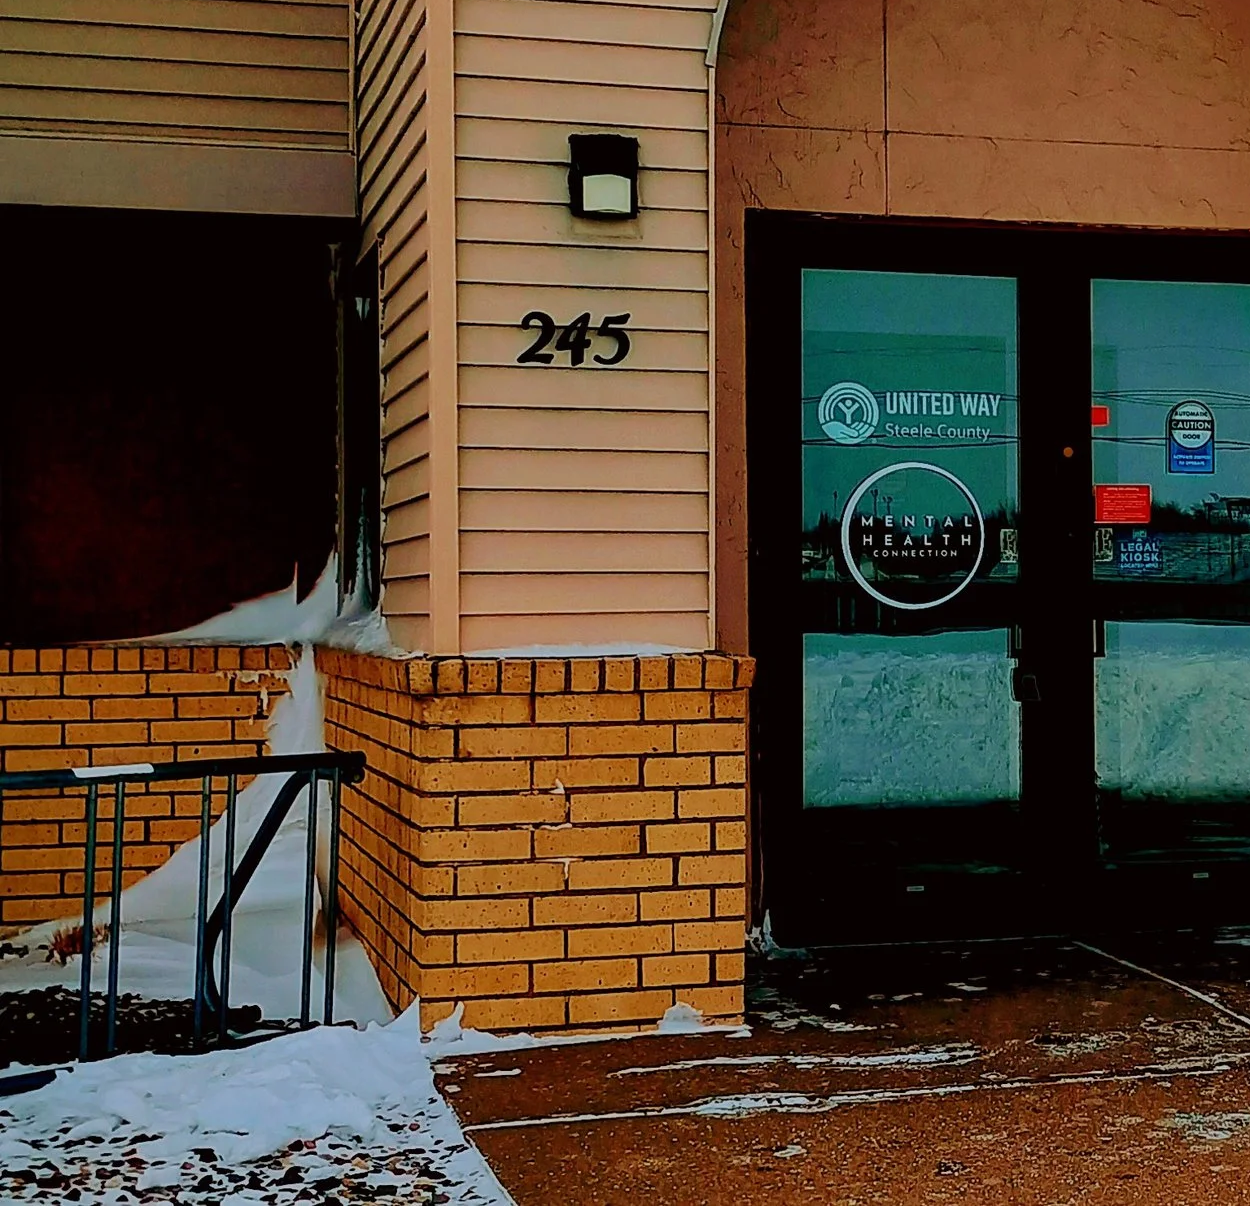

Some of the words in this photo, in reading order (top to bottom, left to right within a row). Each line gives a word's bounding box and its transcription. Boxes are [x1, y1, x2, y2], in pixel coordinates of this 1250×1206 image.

[516, 311, 631, 367] 245
[885, 391, 955, 416] UNITED
[959, 392, 1001, 417] WAY
[1171, 421, 1212, 429] CAUTION
[885, 423, 933, 439] Steele
[937, 424, 991, 442] County
[861, 515, 973, 528] MENTAL
[862, 534, 972, 546] HEALTH
[873, 549, 958, 557] CONNECTION
[1120, 542, 1160, 552] LEGAL
[1120, 552, 1160, 562] KIOSK
